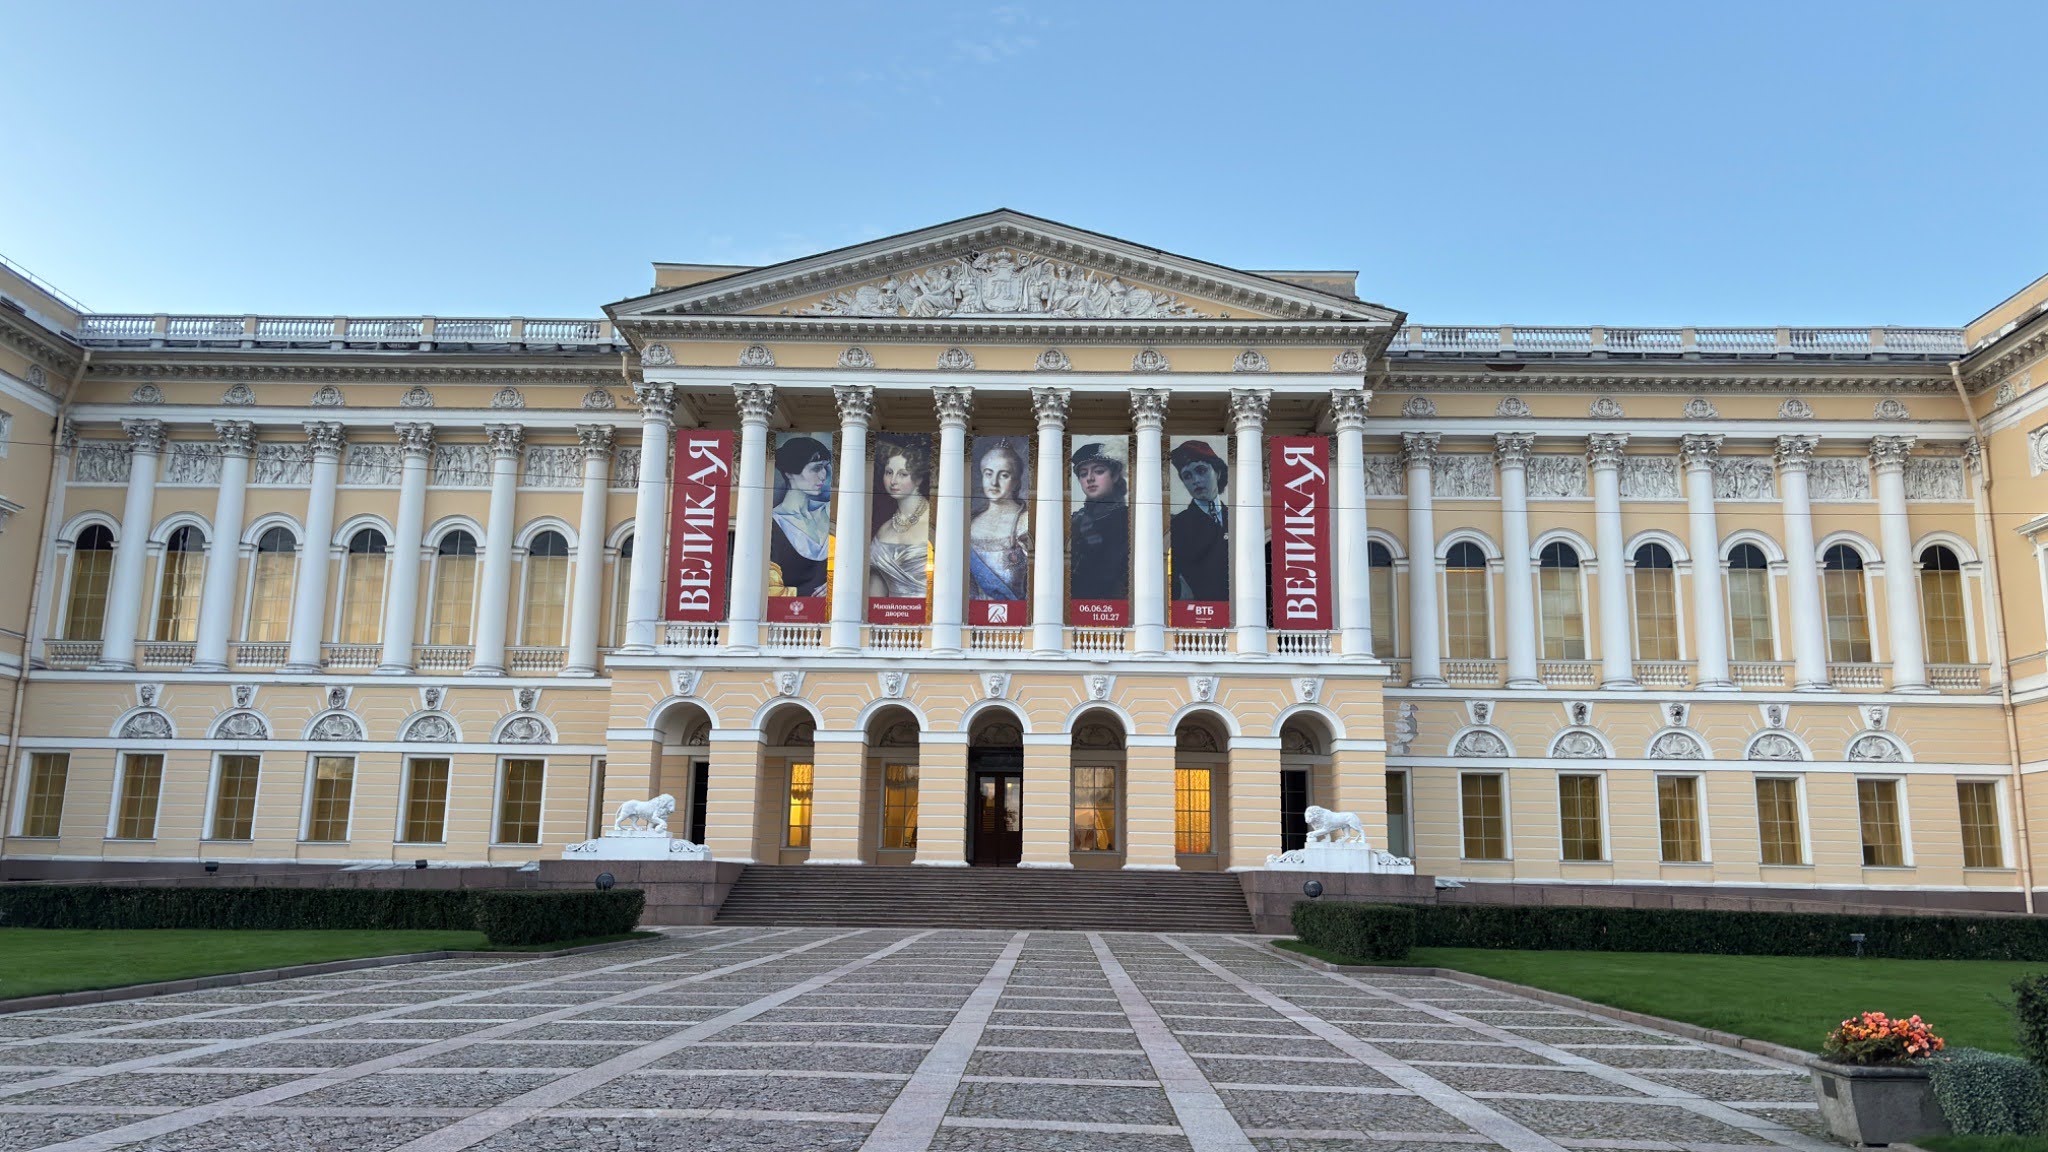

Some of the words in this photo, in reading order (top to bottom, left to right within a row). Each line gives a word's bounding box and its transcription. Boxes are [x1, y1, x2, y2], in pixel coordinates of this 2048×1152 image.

[679, 439, 728, 612] ВЕЛИКАЯ
[1284, 445, 1326, 620] ВЕЛИКАЯ
[1079, 604, 1113, 613] 06.06.26
[1195, 606, 1214, 615] ВТБ
[1092, 613, 1120, 621] 11.01.27
